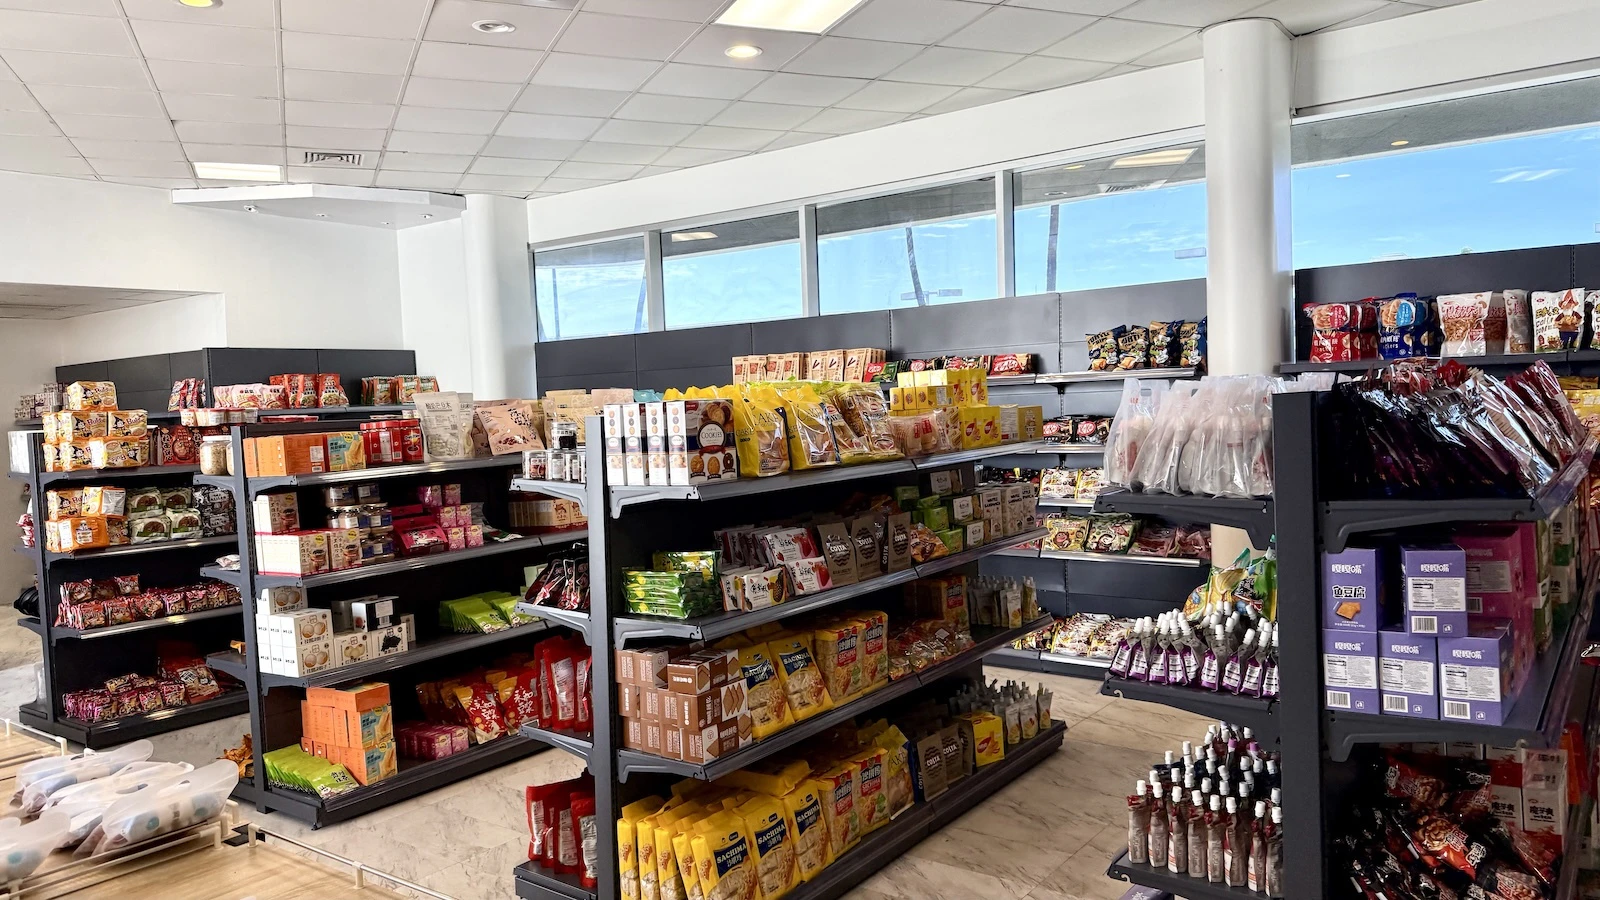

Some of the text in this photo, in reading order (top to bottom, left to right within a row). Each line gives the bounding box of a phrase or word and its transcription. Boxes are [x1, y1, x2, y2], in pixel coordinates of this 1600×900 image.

[857, 537, 874, 547] COSTA
[894, 534, 907, 542] COSTA
[829, 544, 848, 553] COSTA
[1332, 584, 1366, 599] 鱼豆腐
[943, 744, 957, 755] COSTA
[926, 755, 941, 767] COSTA
[797, 805, 819, 823] SACHIMA
[757, 824, 786, 844] SACHIMA
[716, 843, 747, 863] SACHIMA
